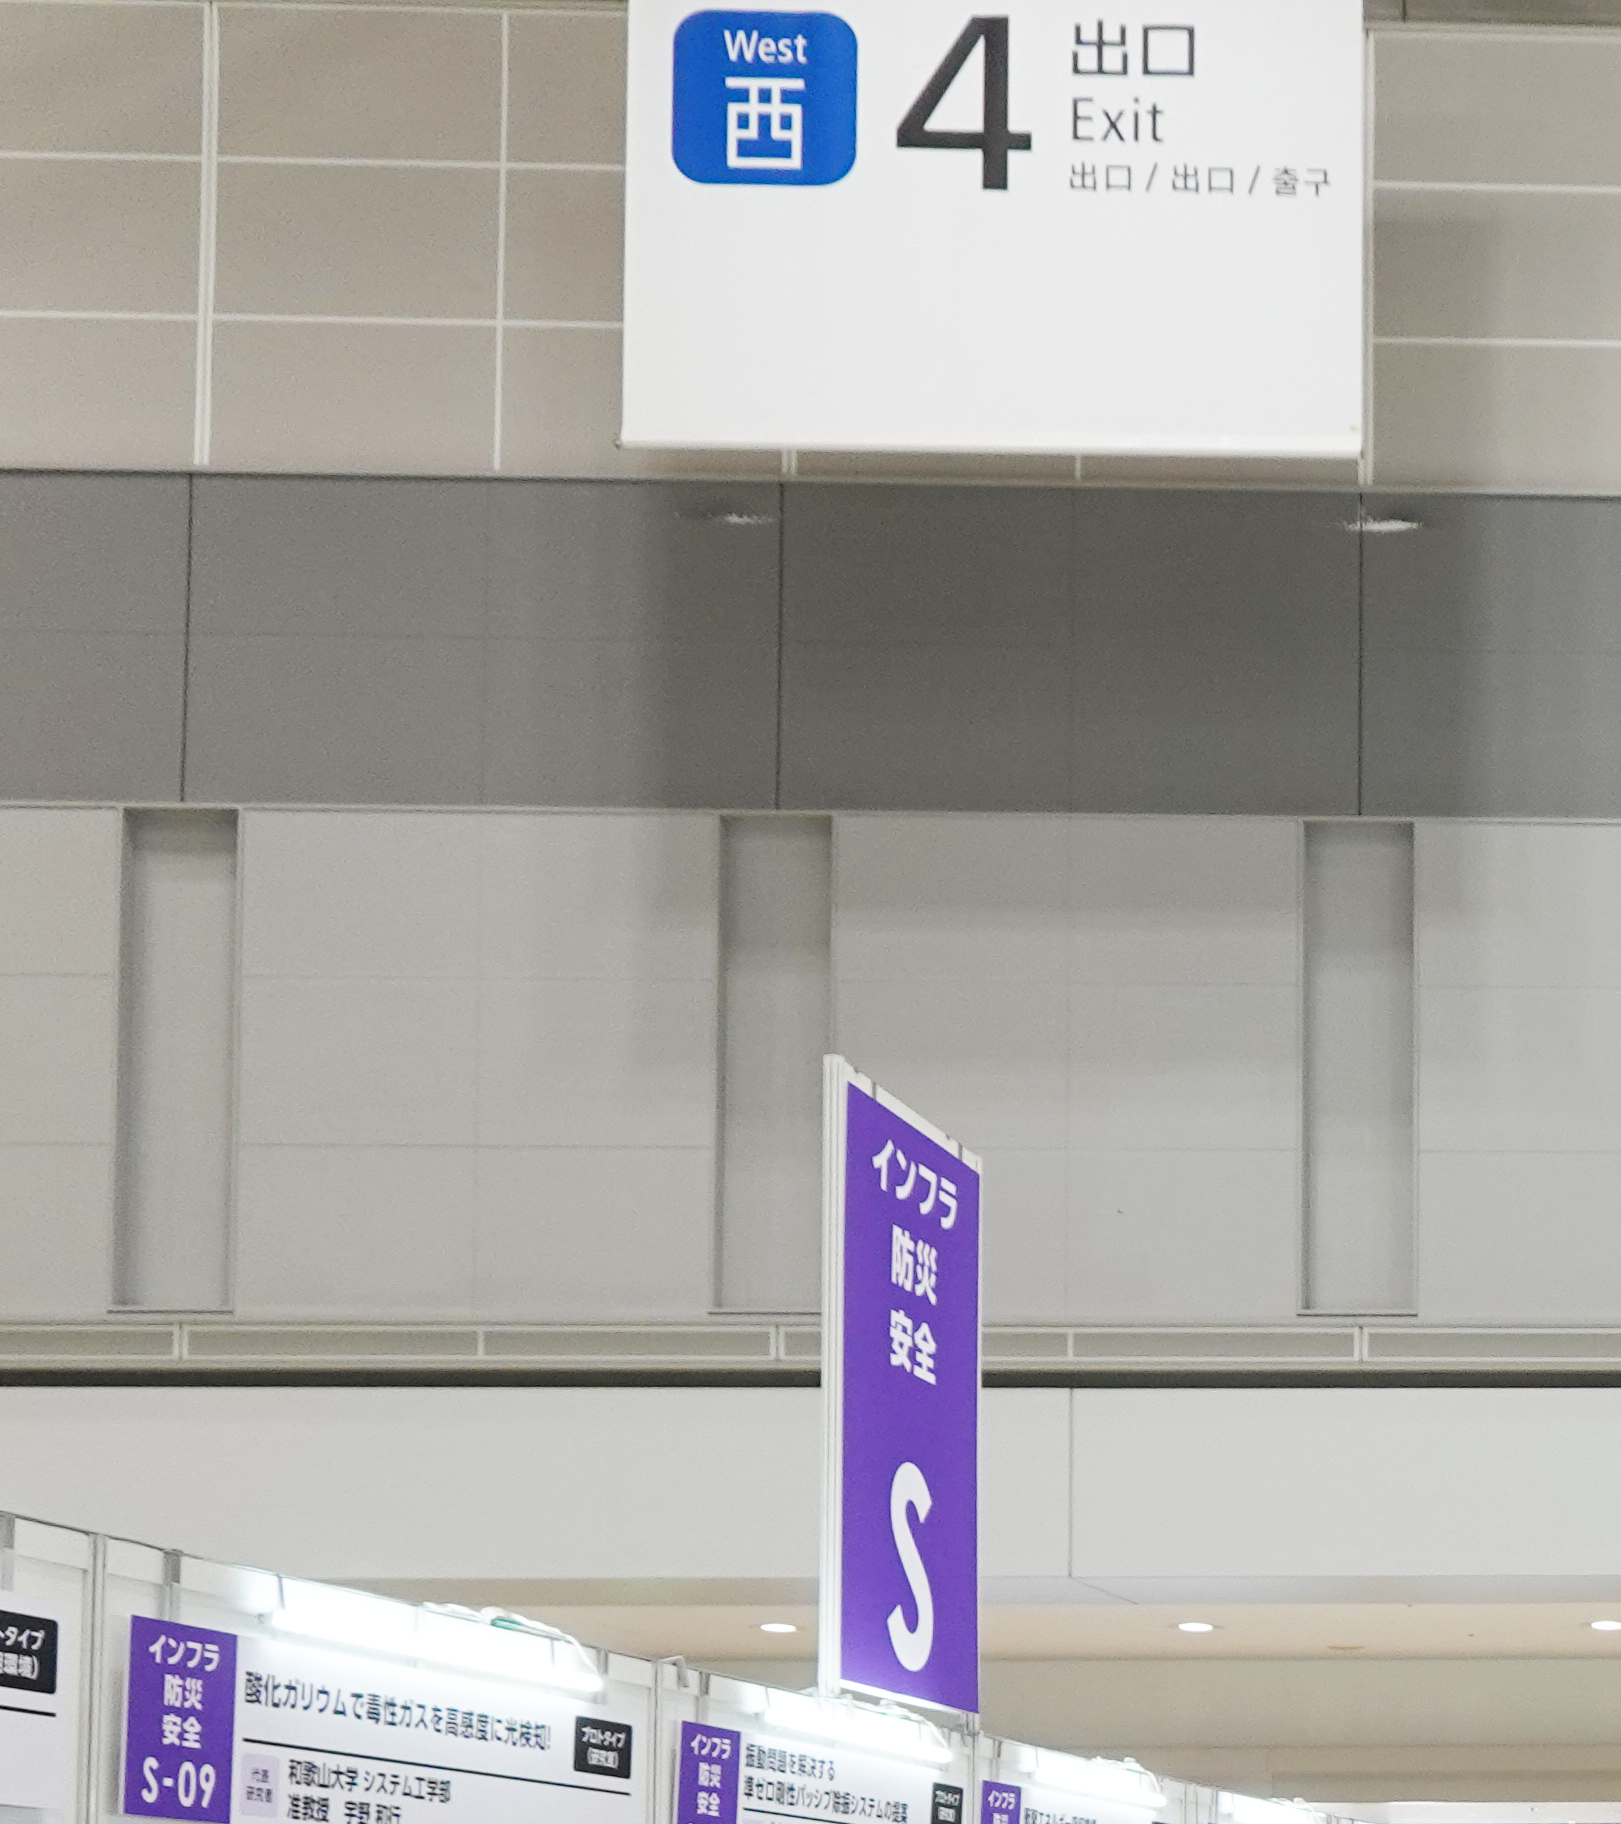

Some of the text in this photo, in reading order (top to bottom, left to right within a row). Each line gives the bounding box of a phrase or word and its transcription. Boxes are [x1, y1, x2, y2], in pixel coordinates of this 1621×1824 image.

[724, 30, 806, 64] West
[1072, 21, 1194, 76] 出口
[725, 77, 804, 169] 西
[896, 16, 1031, 191] 4
[1071, 97, 1164, 143] Exit
[1069, 162, 1133, 192] 出口
[1172, 163, 1234, 194] 出口
[1272, 166, 1331, 197] 출구
[872, 1138, 957, 1231] インフラ
[891, 1224, 937, 1306] 防災
[890, 1310, 936, 1385] 安全
[887, 1461, 933, 1671] S
[0, 1626, 45, 1650] タイプ
[148, 1634, 221, 1672] インフラ
[163, 1674, 204, 1712] 防災
[161, 1712, 203, 1750] 安全
[690, 1734, 732, 1760] インフラ
[141, 1757, 216, 1810] S-09
[288, 1758, 359, 1793] 和歌山大学
[988, 1790, 1016, 1810] インフラ
